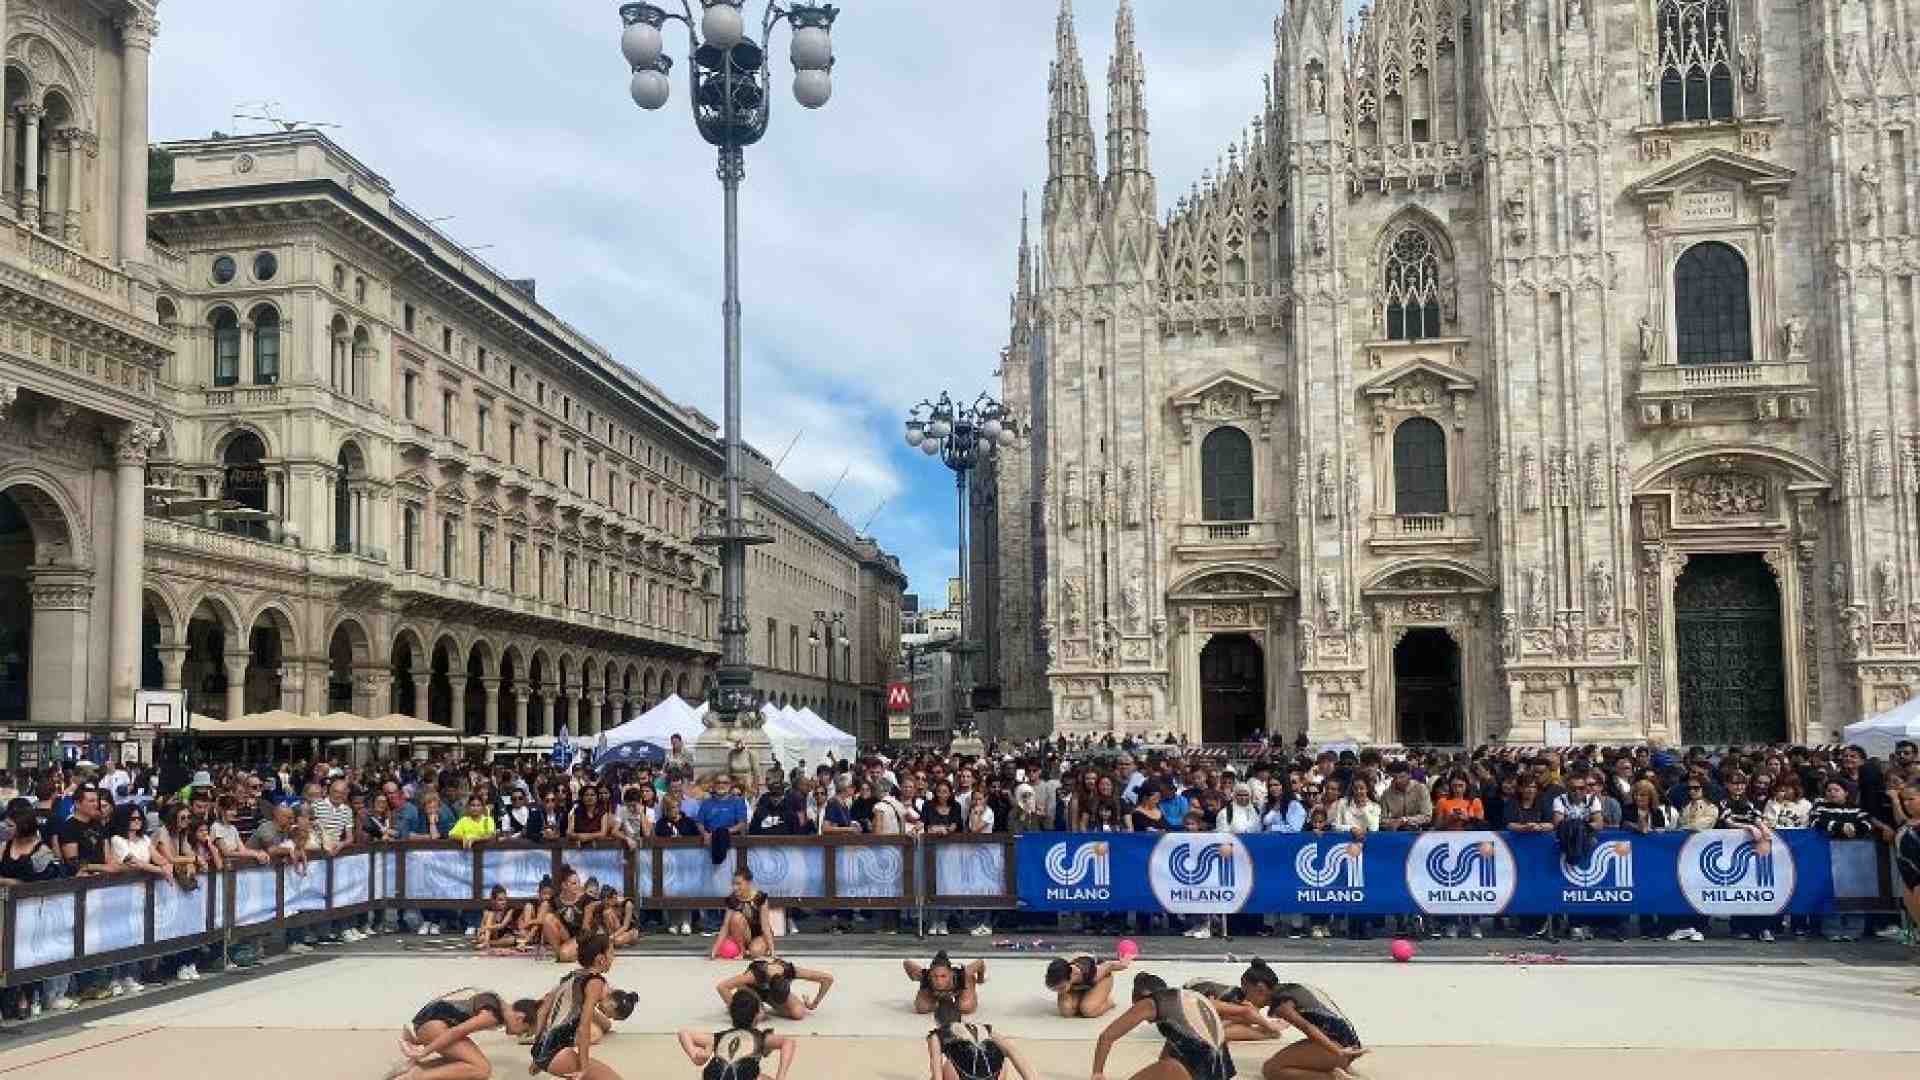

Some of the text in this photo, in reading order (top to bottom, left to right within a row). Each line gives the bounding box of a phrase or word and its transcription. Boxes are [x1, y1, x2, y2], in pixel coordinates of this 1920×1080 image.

[889, 687, 911, 705] M
[1047, 888, 1110, 900] MILANO
[1170, 890, 1235, 902] MILANO
[1297, 890, 1364, 902] MILANO
[1428, 890, 1497, 902] MILANO
[1562, 890, 1633, 902] MILANO
[1701, 890, 1775, 902] MILANO
